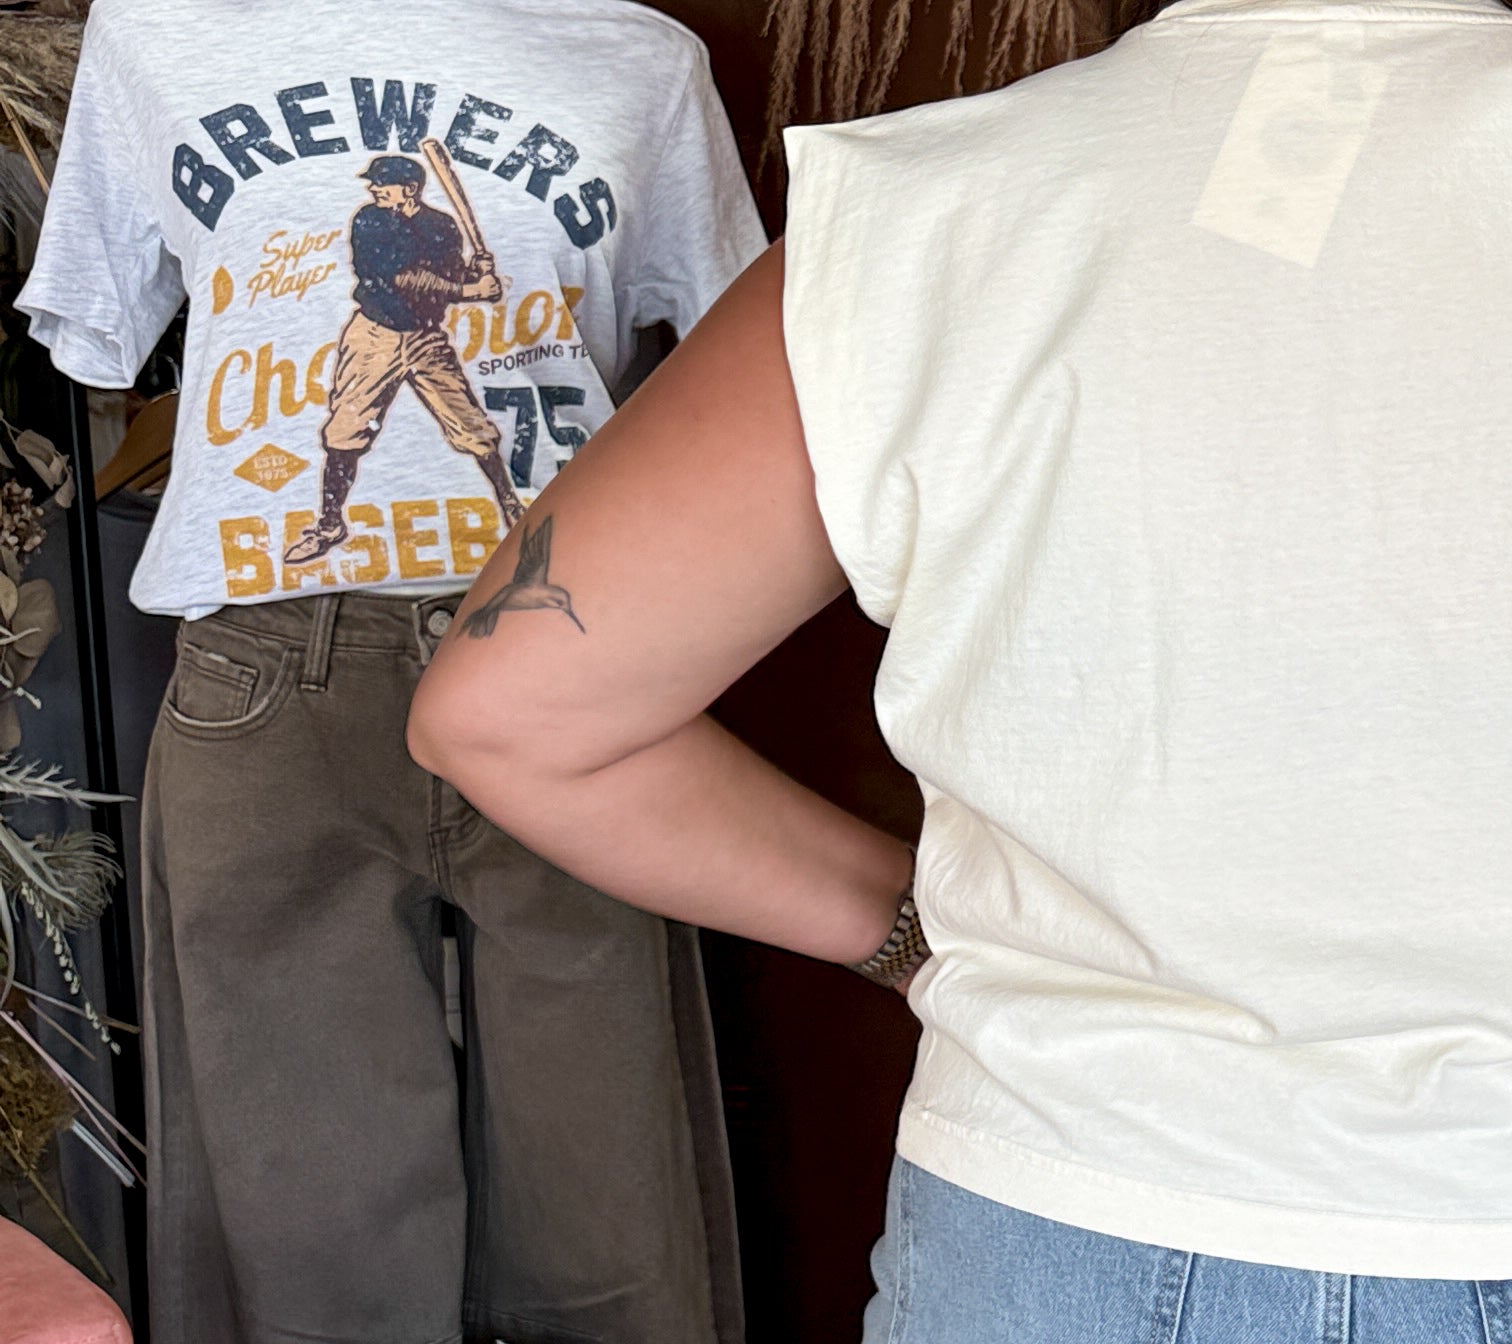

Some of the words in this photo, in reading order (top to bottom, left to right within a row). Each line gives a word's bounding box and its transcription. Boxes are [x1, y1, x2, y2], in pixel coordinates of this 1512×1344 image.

[172, 77, 617, 250] BREWERS
[247, 262, 337, 309] Player
[260, 229, 342, 272] Super
[478, 343, 565, 376] SPORTING
[483, 385, 592, 489] 75
[219, 497, 533, 598] BASEB
